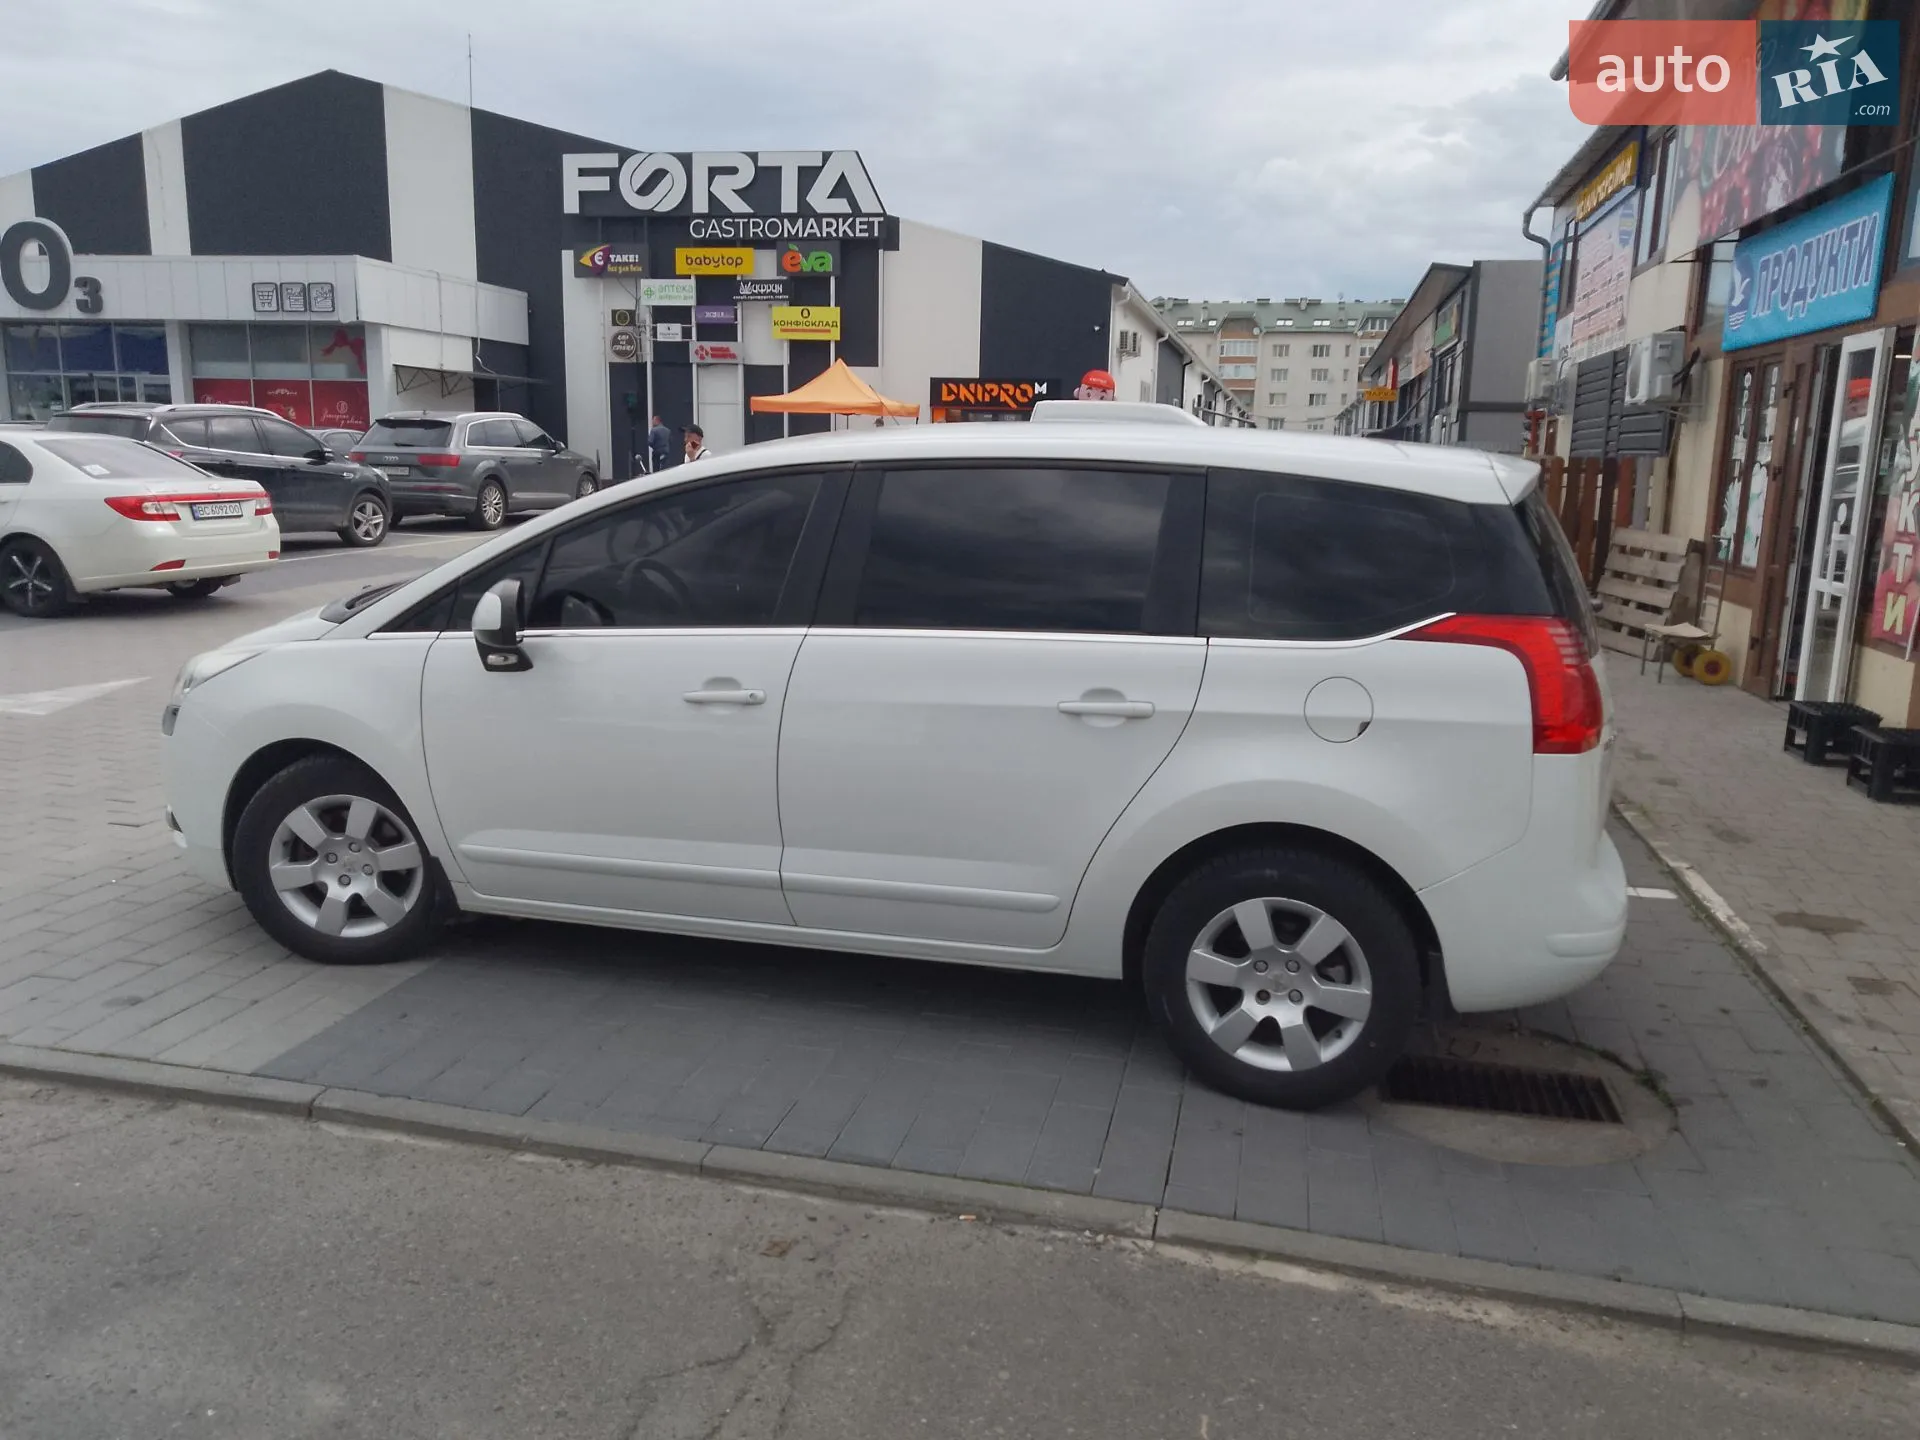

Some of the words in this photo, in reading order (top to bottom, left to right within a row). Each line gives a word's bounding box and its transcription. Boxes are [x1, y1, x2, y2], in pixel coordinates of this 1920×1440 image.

[562, 150, 886, 215] FORTA
[689, 216, 885, 239] GASTROMARKET
[685, 254, 744, 268] babytop
[1751, 211, 1879, 320] ПРОДУКТИ
[773, 320, 839, 328] КОНФІСКЛАД
[941, 382, 1033, 409] DNIPRO
